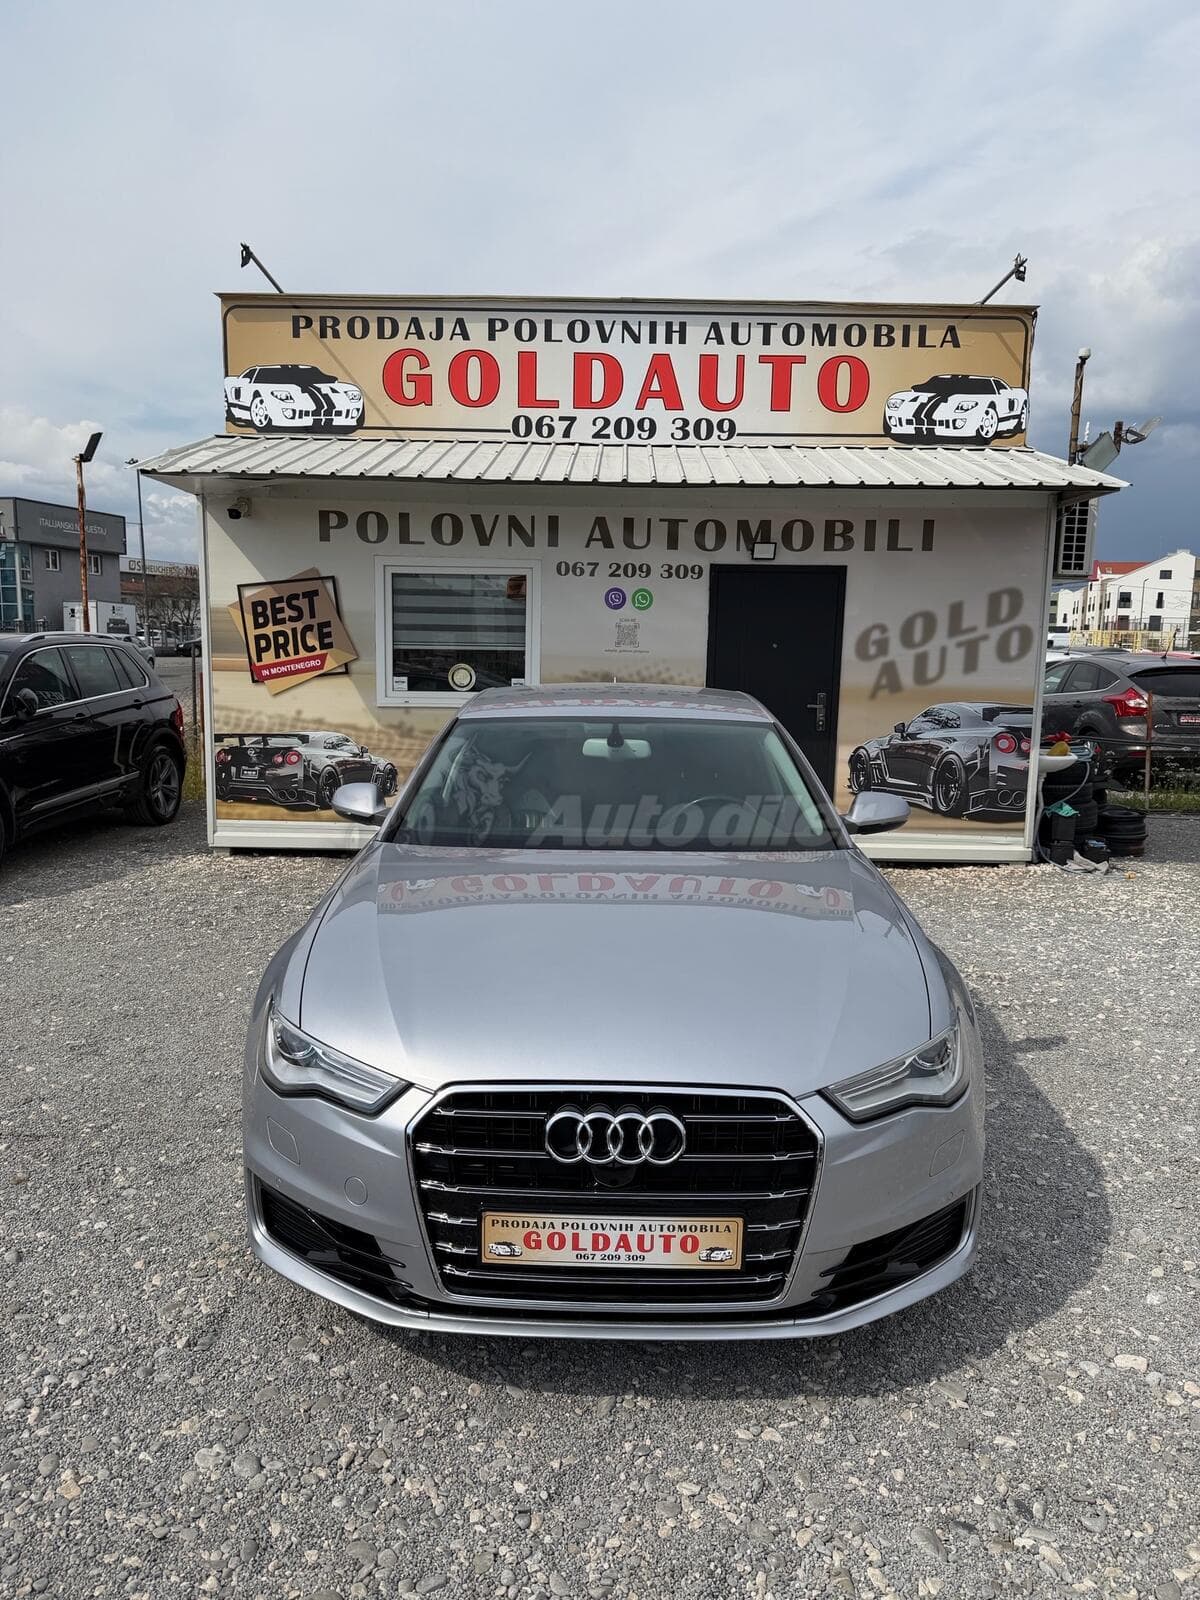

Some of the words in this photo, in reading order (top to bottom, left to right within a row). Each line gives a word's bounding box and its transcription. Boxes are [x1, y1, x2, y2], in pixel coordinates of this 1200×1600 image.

[291, 314, 471, 342] PRODAJA
[487, 317, 687, 345] POLOVNIH
[703, 321, 961, 349] AUTOMOBILA
[381, 347, 871, 414] GOLDAUTO
[510, 414, 578, 439] 067
[591, 415, 657, 440] 209
[670, 417, 737, 441] 309
[318, 509, 560, 548] POLOVNI
[584, 515, 936, 553] AUTOMOBILI
[555, 560, 600, 578] 067
[608, 561, 652, 579] 209
[660, 563, 704, 580] 309
[251, 589, 319, 630] BEST
[853, 586, 1025, 662] GOLD
[254, 620, 334, 663] PRICE
[261, 668, 270, 676] IN
[270, 659, 321, 675] MONTENEGRO
[868, 622, 1035, 700] AUTO
[490, 1218, 556, 1230] PRODAJA
[561, 1221, 634, 1232] POLOVNIH
[639, 1223, 732, 1234] AUTOMOBILA
[522, 1230, 700, 1255] GOLDAUTO
[575, 1253, 596, 1261] 067
[600, 1253, 621, 1262] 209
[624, 1254, 646, 1262] 309
